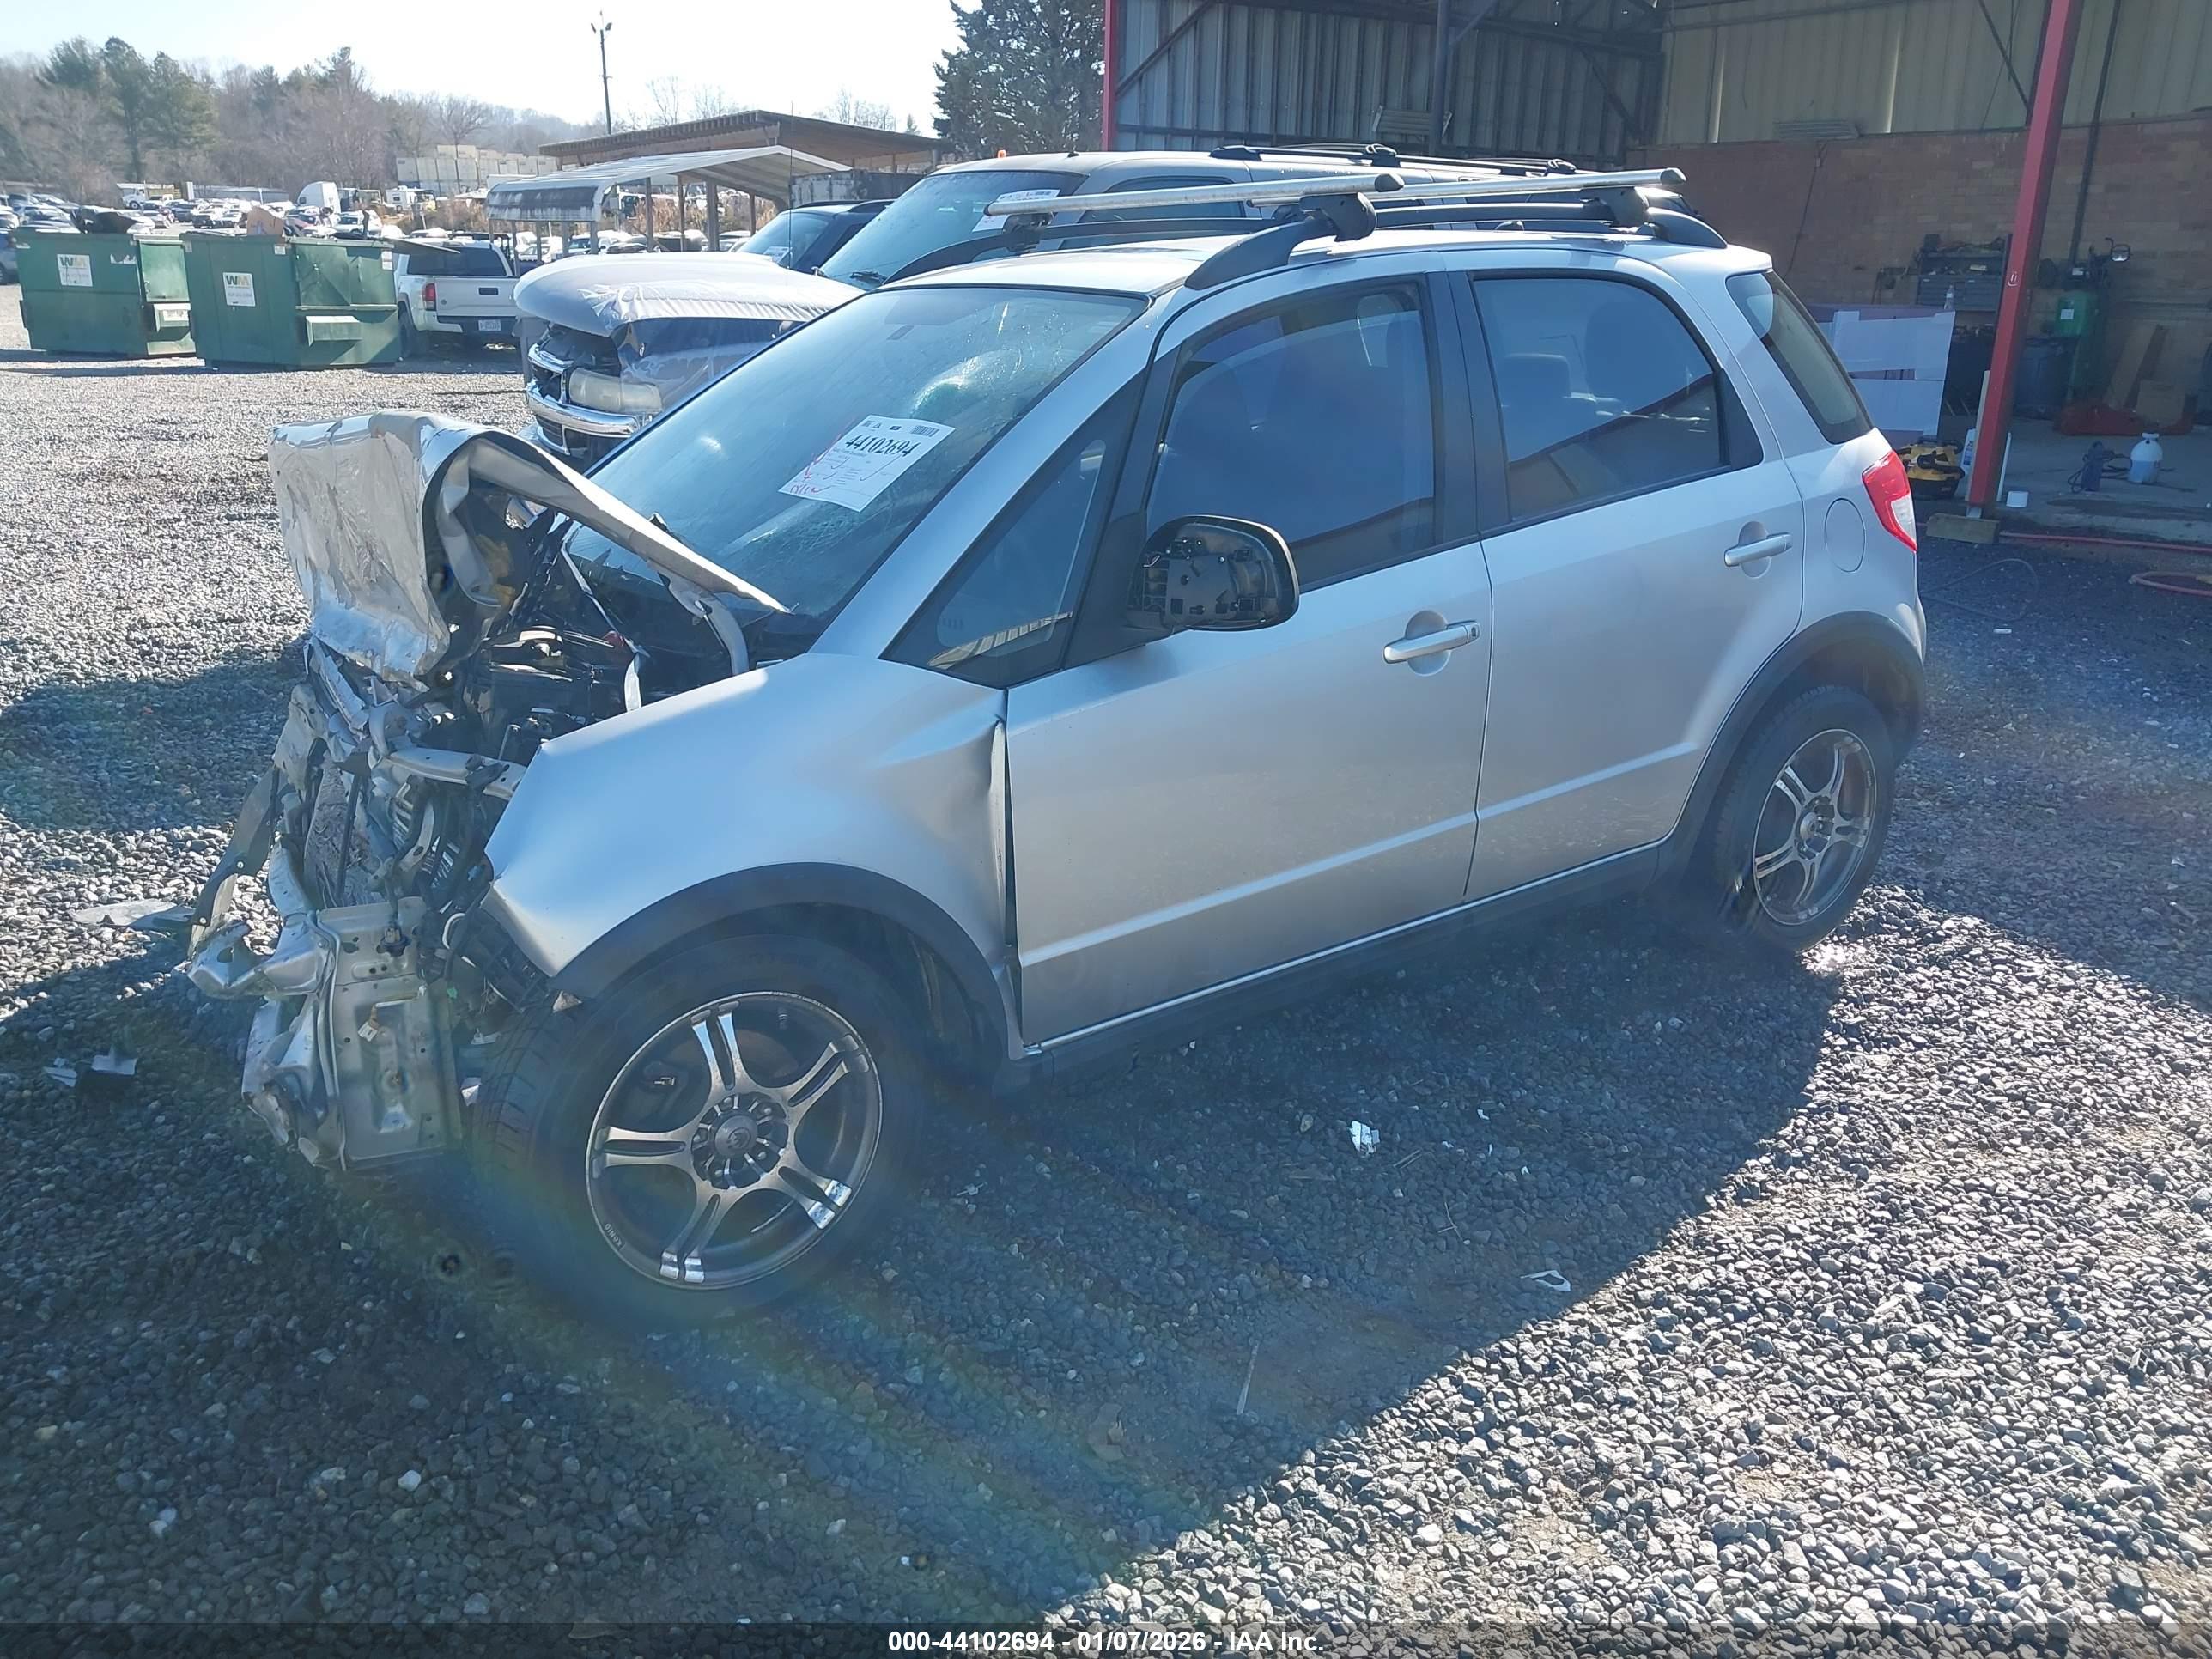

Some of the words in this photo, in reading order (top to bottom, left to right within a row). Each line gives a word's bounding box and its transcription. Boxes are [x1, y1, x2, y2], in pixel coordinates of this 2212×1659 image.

[59, 257, 87, 267] WM
[225, 275, 250, 286] WM
[845, 434, 921, 458] 44102694
